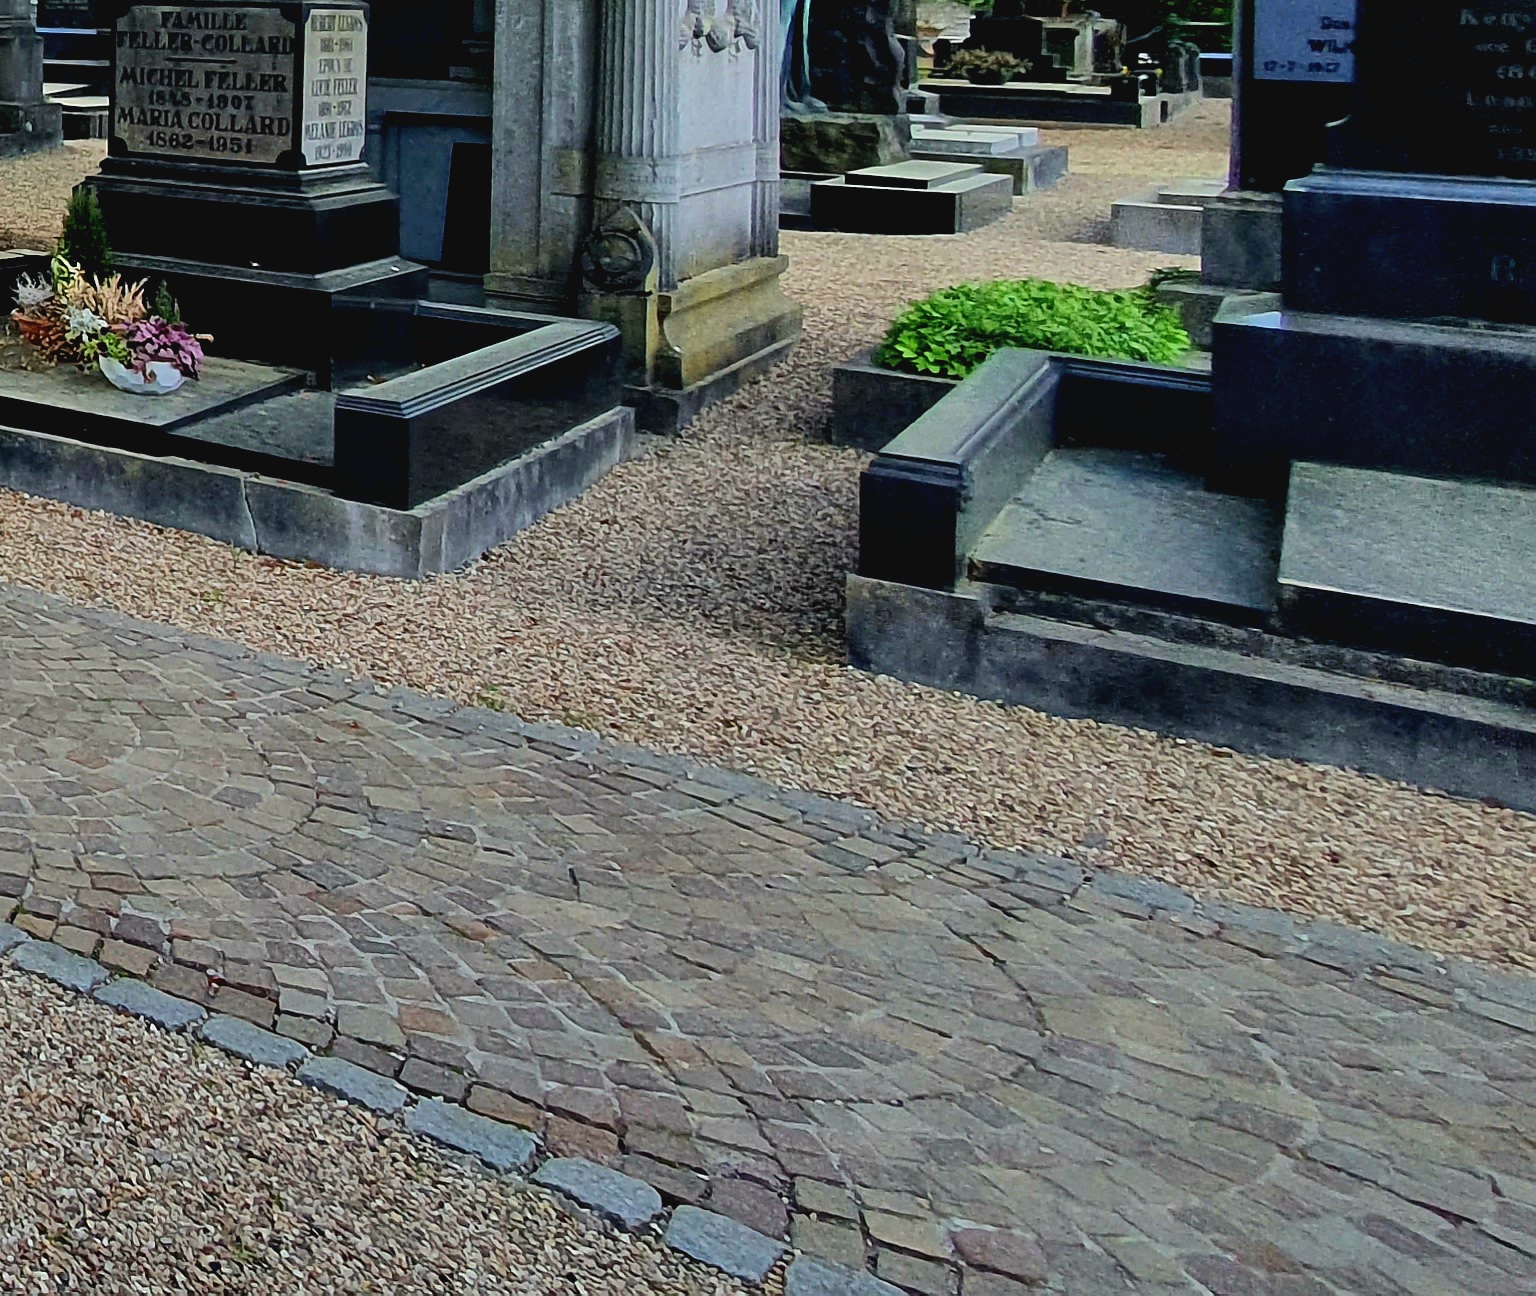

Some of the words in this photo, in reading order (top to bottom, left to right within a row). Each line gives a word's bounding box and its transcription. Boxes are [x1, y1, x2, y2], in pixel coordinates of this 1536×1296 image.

[160, 11, 247, 31] FAMILLE
[116, 30, 294, 55] FELLER-COLLARD
[118, 66, 199, 89] MICHEL
[204, 70, 289, 93] FELLER
[116, 106, 185, 130] MARIA
[187, 111, 291, 137] COLLARD
